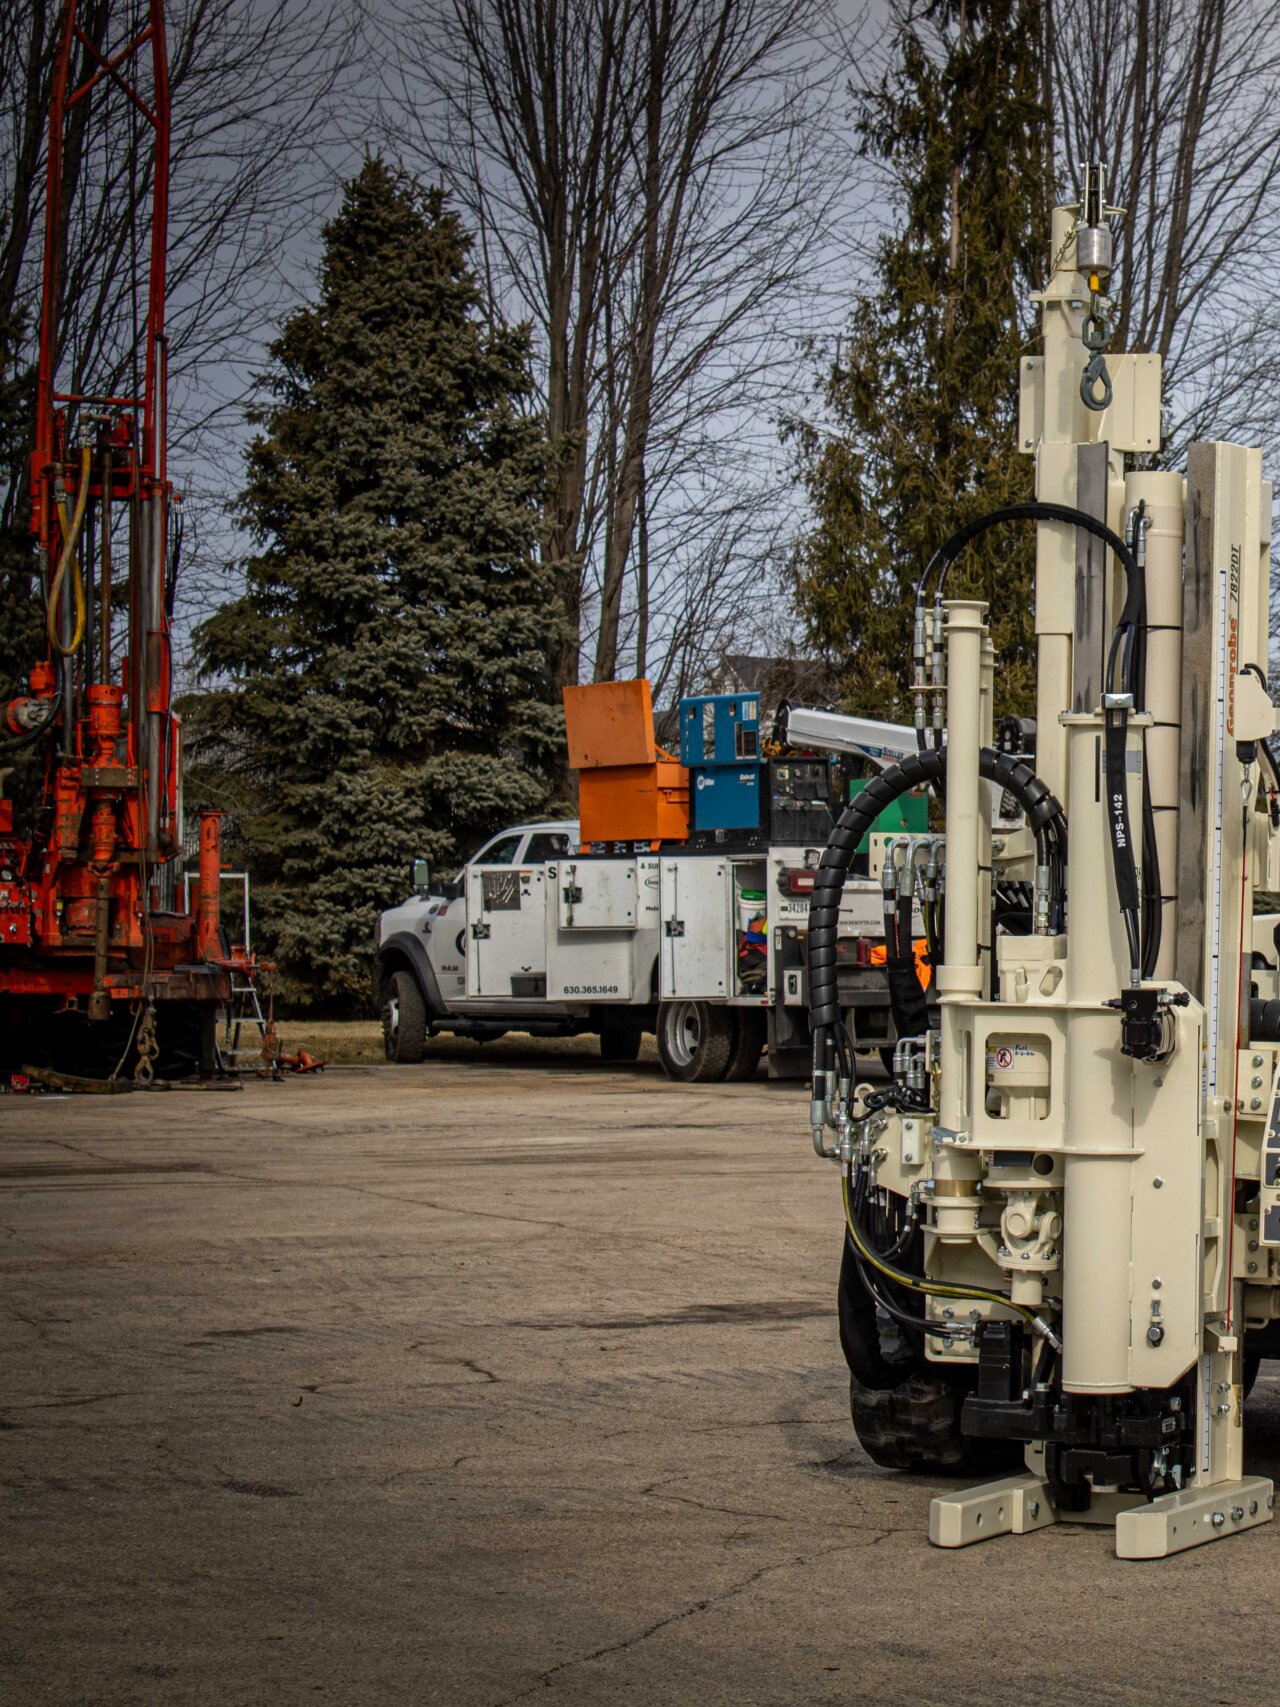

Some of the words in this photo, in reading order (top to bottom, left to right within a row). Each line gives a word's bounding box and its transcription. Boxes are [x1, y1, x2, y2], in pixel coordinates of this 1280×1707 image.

[1230, 544, 1239, 603] 7822DT
[1113, 794, 1126, 848] NPS-142
[787, 903, 810, 913] 34284
[563, 986, 618, 994] 630.365.1649
